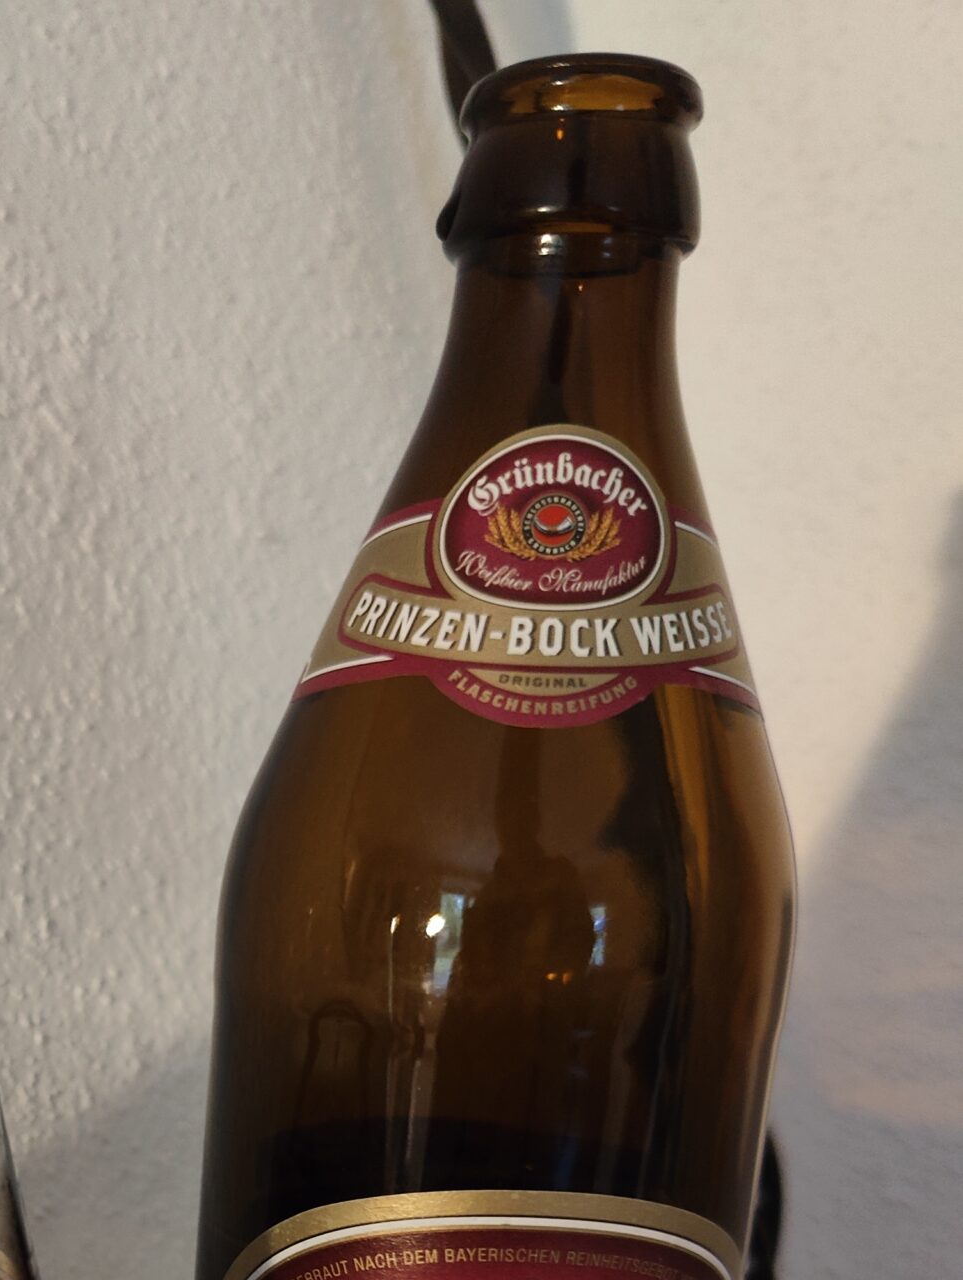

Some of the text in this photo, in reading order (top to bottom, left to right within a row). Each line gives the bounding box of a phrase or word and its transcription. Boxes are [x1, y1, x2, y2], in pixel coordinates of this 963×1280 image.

[467, 453, 648, 516] Grünbacher
[455, 550, 647, 595] Weißbier Manufaktur
[346, 591, 732, 658] PRINZEN-BOCK WEISSE
[447, 669, 638, 716] FLASCHENREIFUNG
[498, 673, 588, 689] ORIGINAL
[353, 1252, 398, 1273] NACH
[402, 1248, 439, 1266] DEM
[444, 1247, 561, 1264] BAYERISCHEN
